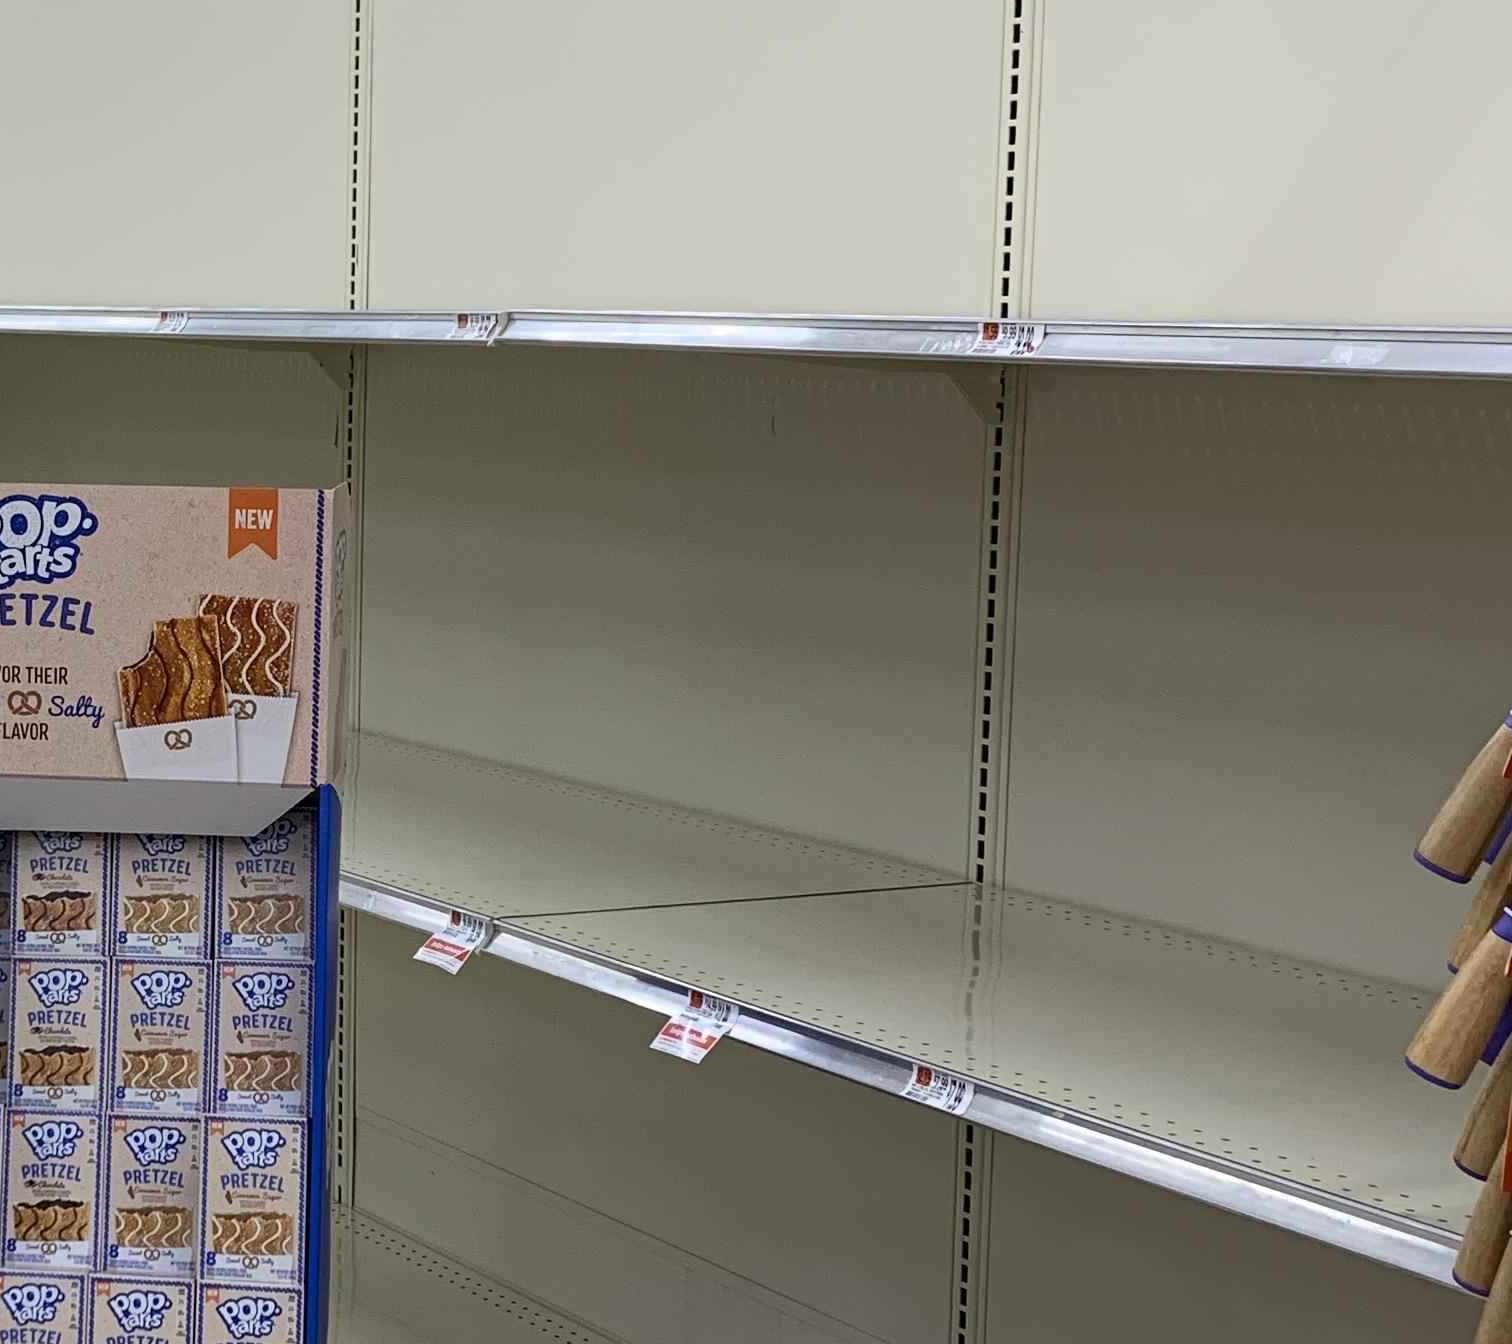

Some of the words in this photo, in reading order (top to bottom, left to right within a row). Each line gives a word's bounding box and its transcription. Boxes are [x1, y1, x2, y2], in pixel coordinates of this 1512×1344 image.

[234, 507, 274, 530] NEW
[25, 666, 68, 685] THEIR
[48, 695, 105, 729] Salty
[30, 856, 88, 874] PRETZEL
[132, 858, 191, 876] PRETZEL
[235, 859, 296, 876] PRETZEL
[17, 930, 27, 942] 8
[118, 931, 127, 944] 8
[223, 932, 232, 945] 8
[28, 1009, 87, 1028] PRETZEL
[131, 1012, 190, 1030] PRETZEL
[232, 1014, 293, 1032] PRETZEL
[14, 1084, 23, 1097] 8
[116, 1086, 125, 1099] 8
[219, 1088, 228, 1102] 8
[22, 1163, 81, 1182] PRETZEL
[123, 1169, 184, 1188] PRETZEL
[221, 1173, 284, 1192] PRETZEL
[7, 1239, 16, 1251] 8
[109, 1245, 118, 1258] 8
[207, 1252, 216, 1265] 8
